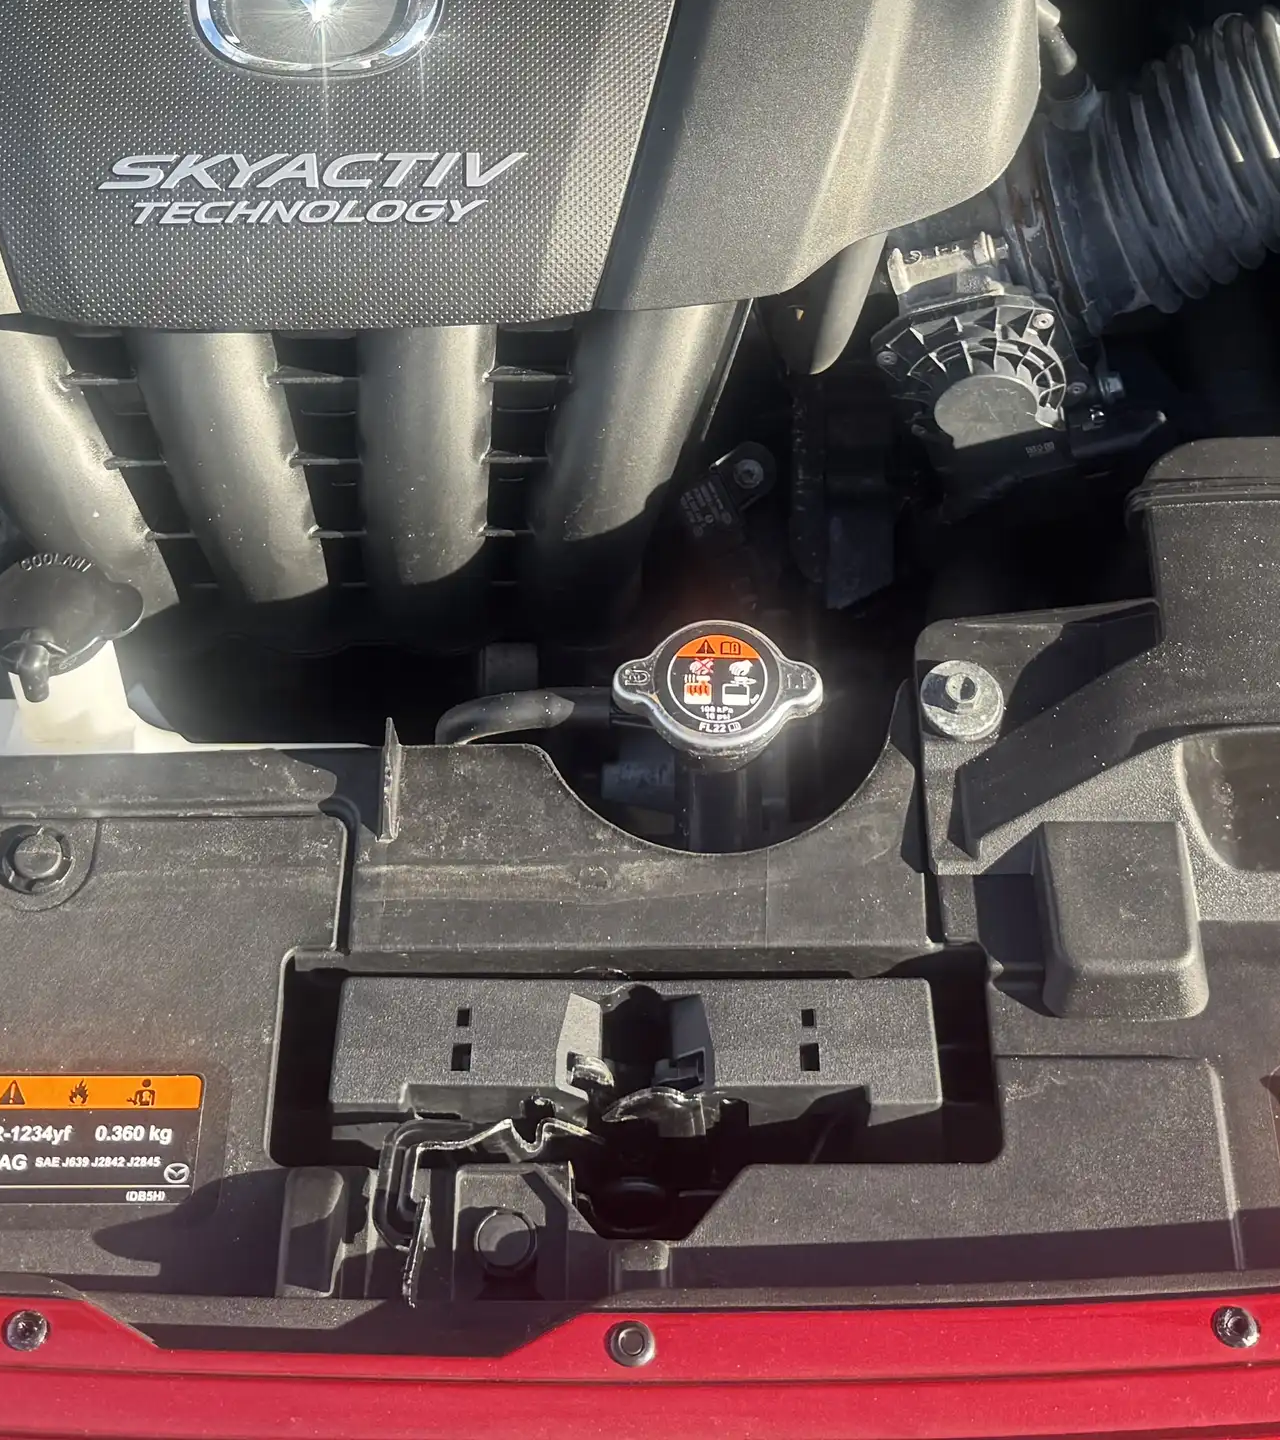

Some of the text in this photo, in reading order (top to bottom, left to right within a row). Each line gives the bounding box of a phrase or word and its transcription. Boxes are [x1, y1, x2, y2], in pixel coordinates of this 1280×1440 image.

[97, 152, 528, 192] SKYACTIV
[131, 198, 489, 225] TECHNOLOGY
[20, 552, 96, 573] COOLANT
[698, 721, 727, 733] FL22
[94, 1125, 144, 1142] 0.360
[148, 1124, 173, 1145] kg
[35, 1156, 61, 1168] SAE
[61, 1156, 90, 1168] J639
[91, 1156, 125, 1168] J2842
[126, 1156, 161, 1168] J2845
[125, 1190, 166, 1202] (DB5H)
